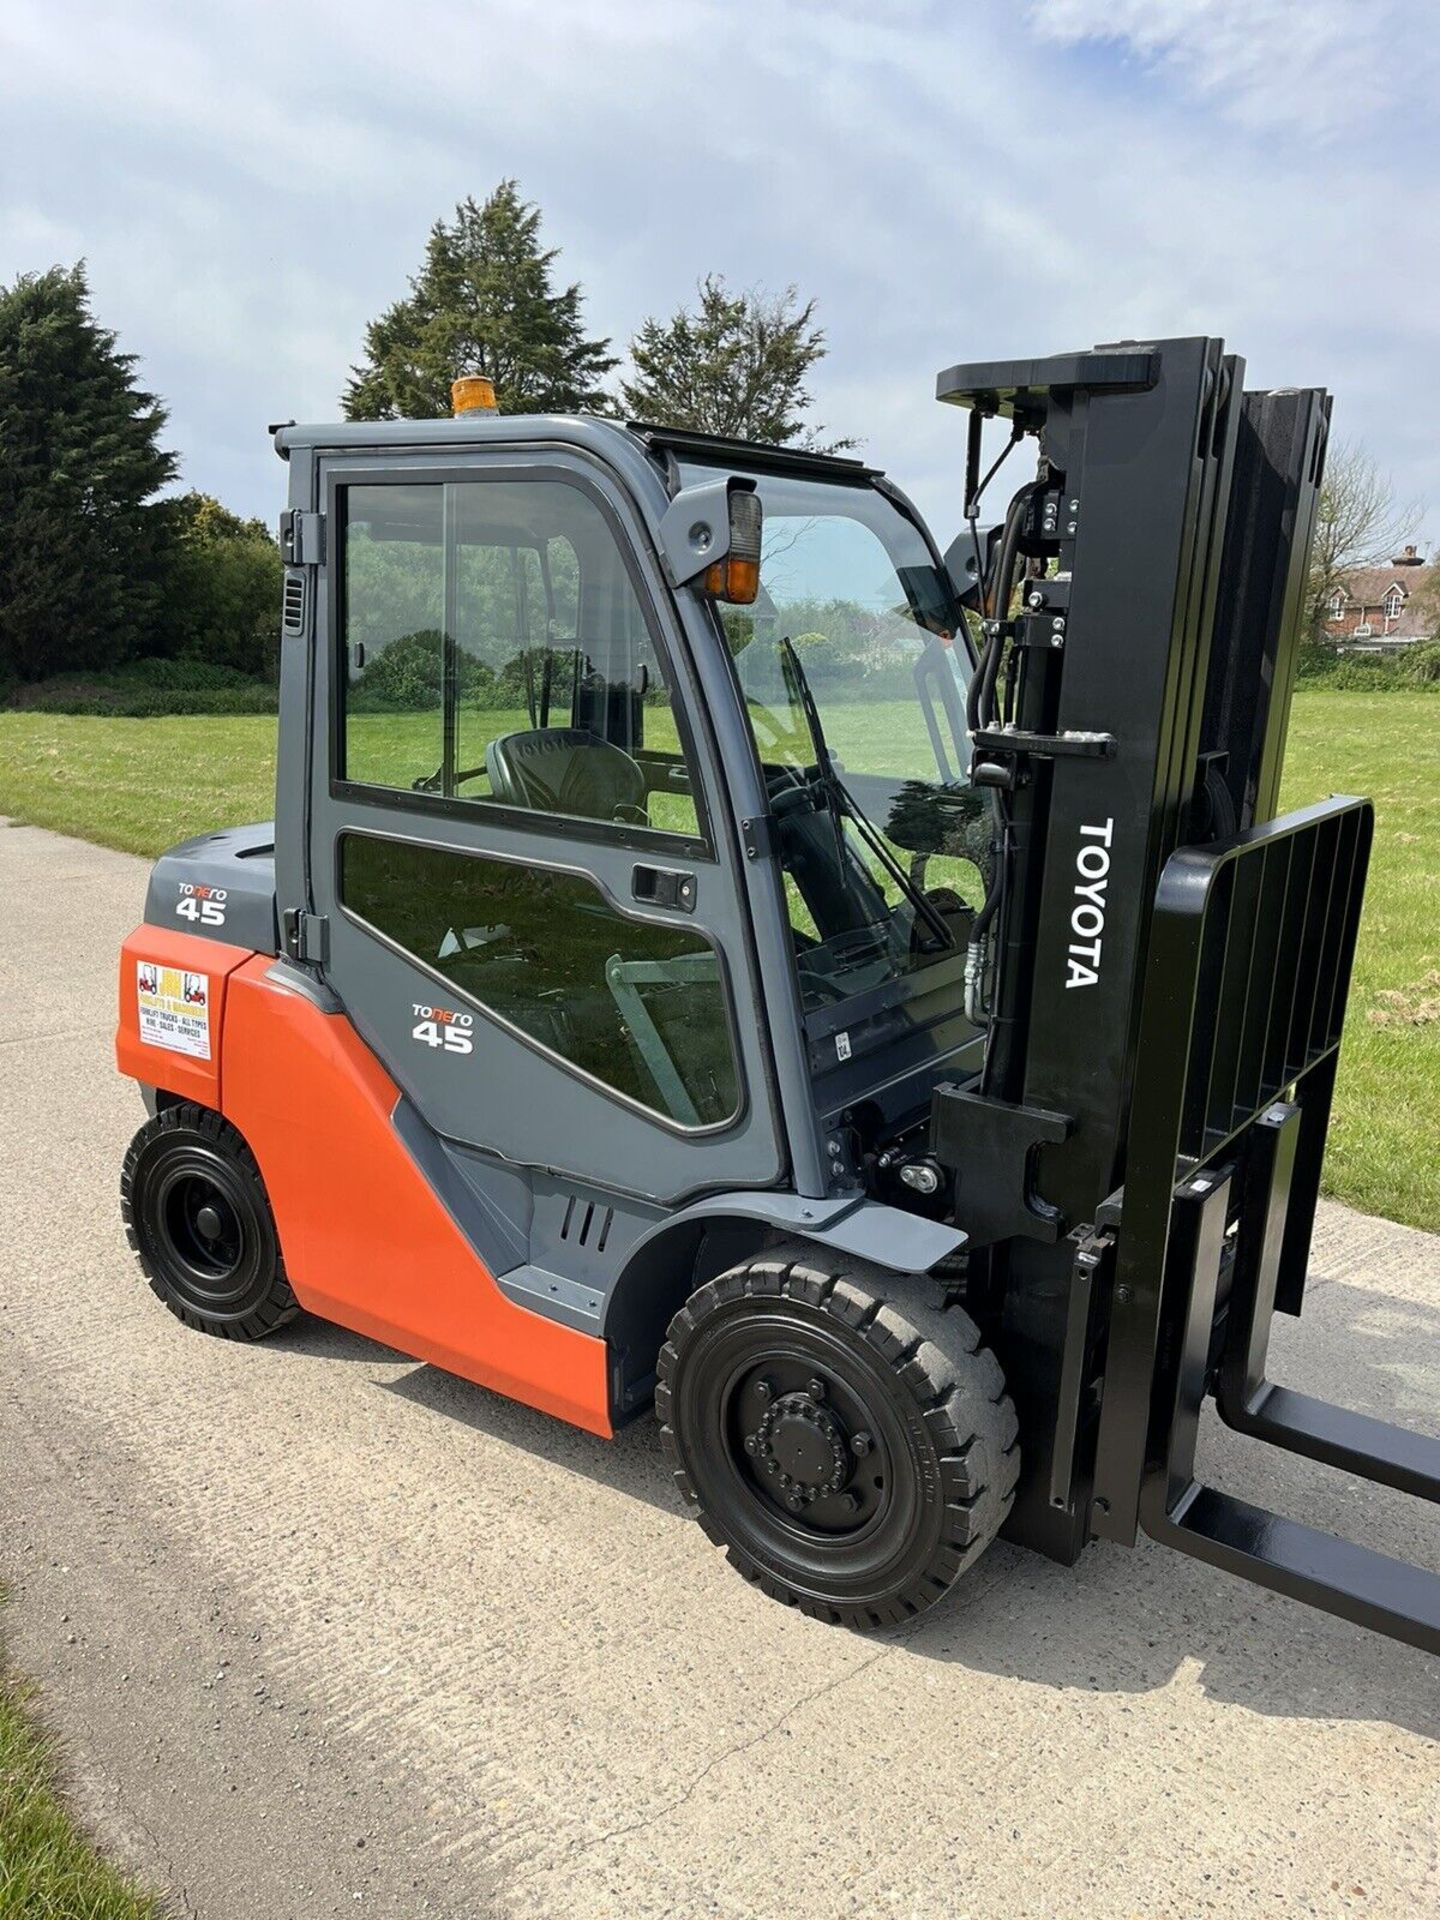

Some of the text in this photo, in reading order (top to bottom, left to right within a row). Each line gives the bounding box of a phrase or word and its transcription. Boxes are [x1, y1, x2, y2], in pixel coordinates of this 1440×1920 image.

[175, 897, 226, 926] 45
[1065, 817, 1114, 989] TOYOTA
[412, 1020, 473, 1055] 45
